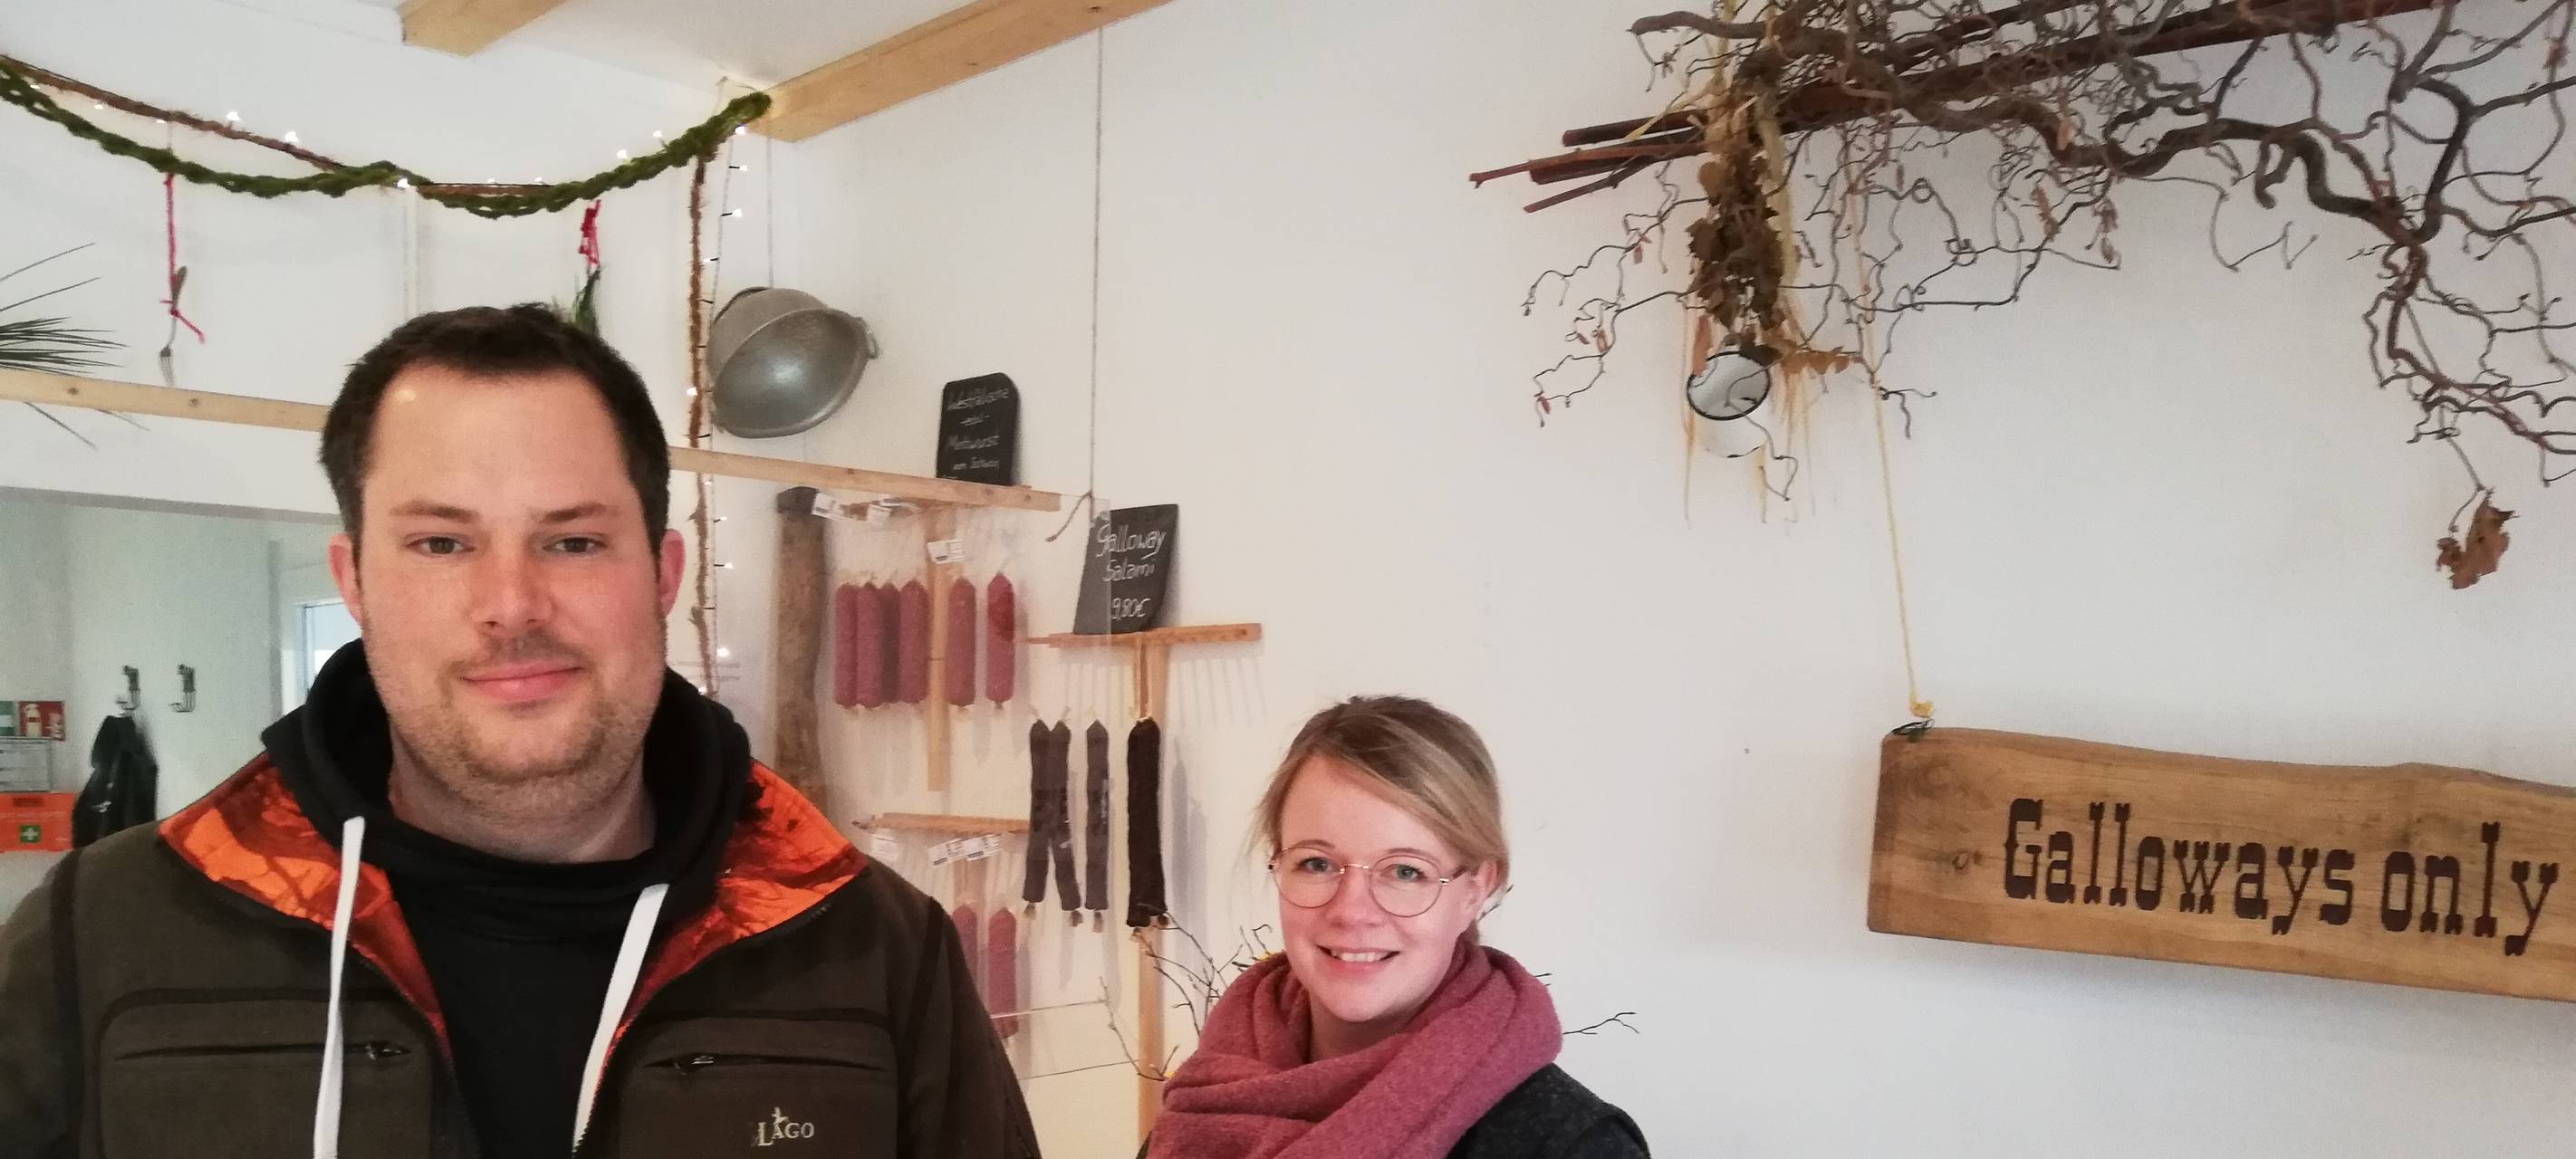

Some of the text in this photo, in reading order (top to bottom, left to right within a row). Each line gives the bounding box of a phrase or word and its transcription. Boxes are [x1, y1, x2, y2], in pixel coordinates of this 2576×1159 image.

[1095, 523, 1167, 560] Galloway
[1101, 558, 1156, 582] Salami
[1111, 597, 1151, 621] 9,80€
[2004, 797, 2561, 958] Galloways only
[756, 1120, 815, 1147] LAGO
